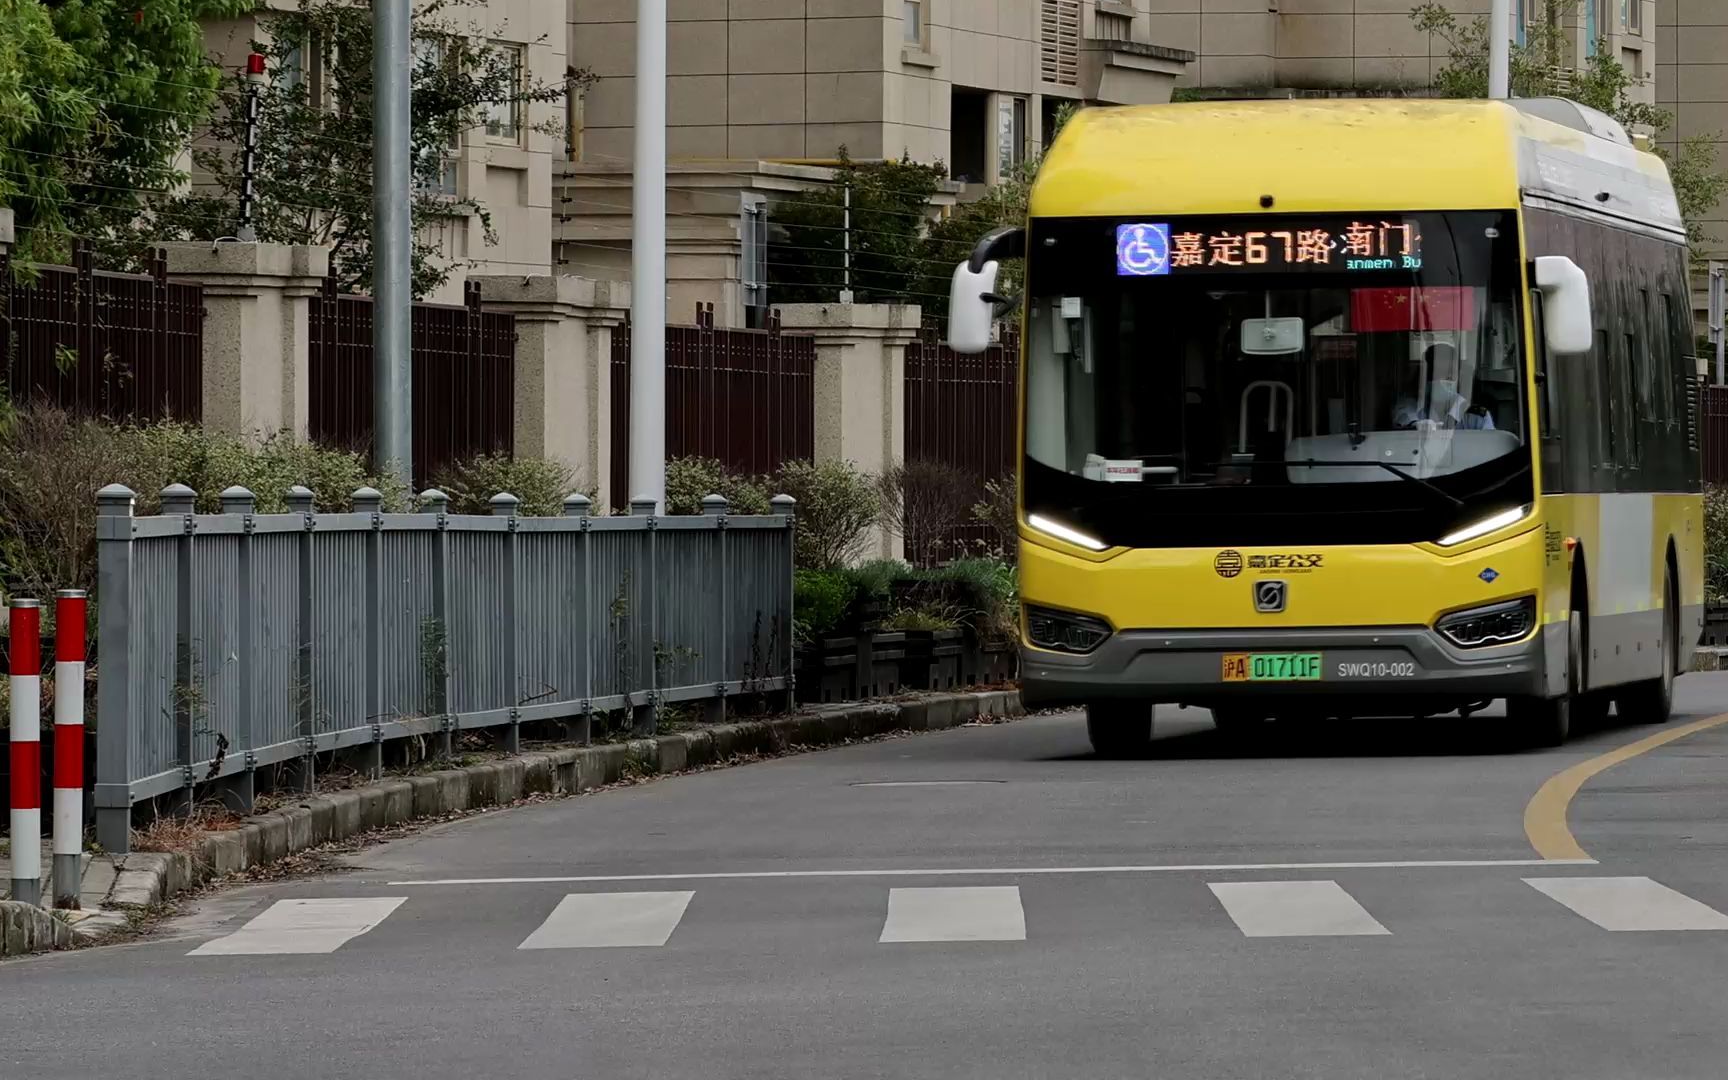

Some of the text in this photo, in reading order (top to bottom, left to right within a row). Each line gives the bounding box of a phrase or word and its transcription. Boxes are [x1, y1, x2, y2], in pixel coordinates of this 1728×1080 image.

[1170, 229, 1331, 267] 嘉定67路
[1345, 220, 1421, 256] 南门
[1254, 657, 1320, 678] 01711F
[1338, 663, 1414, 677] SWQ10-002
